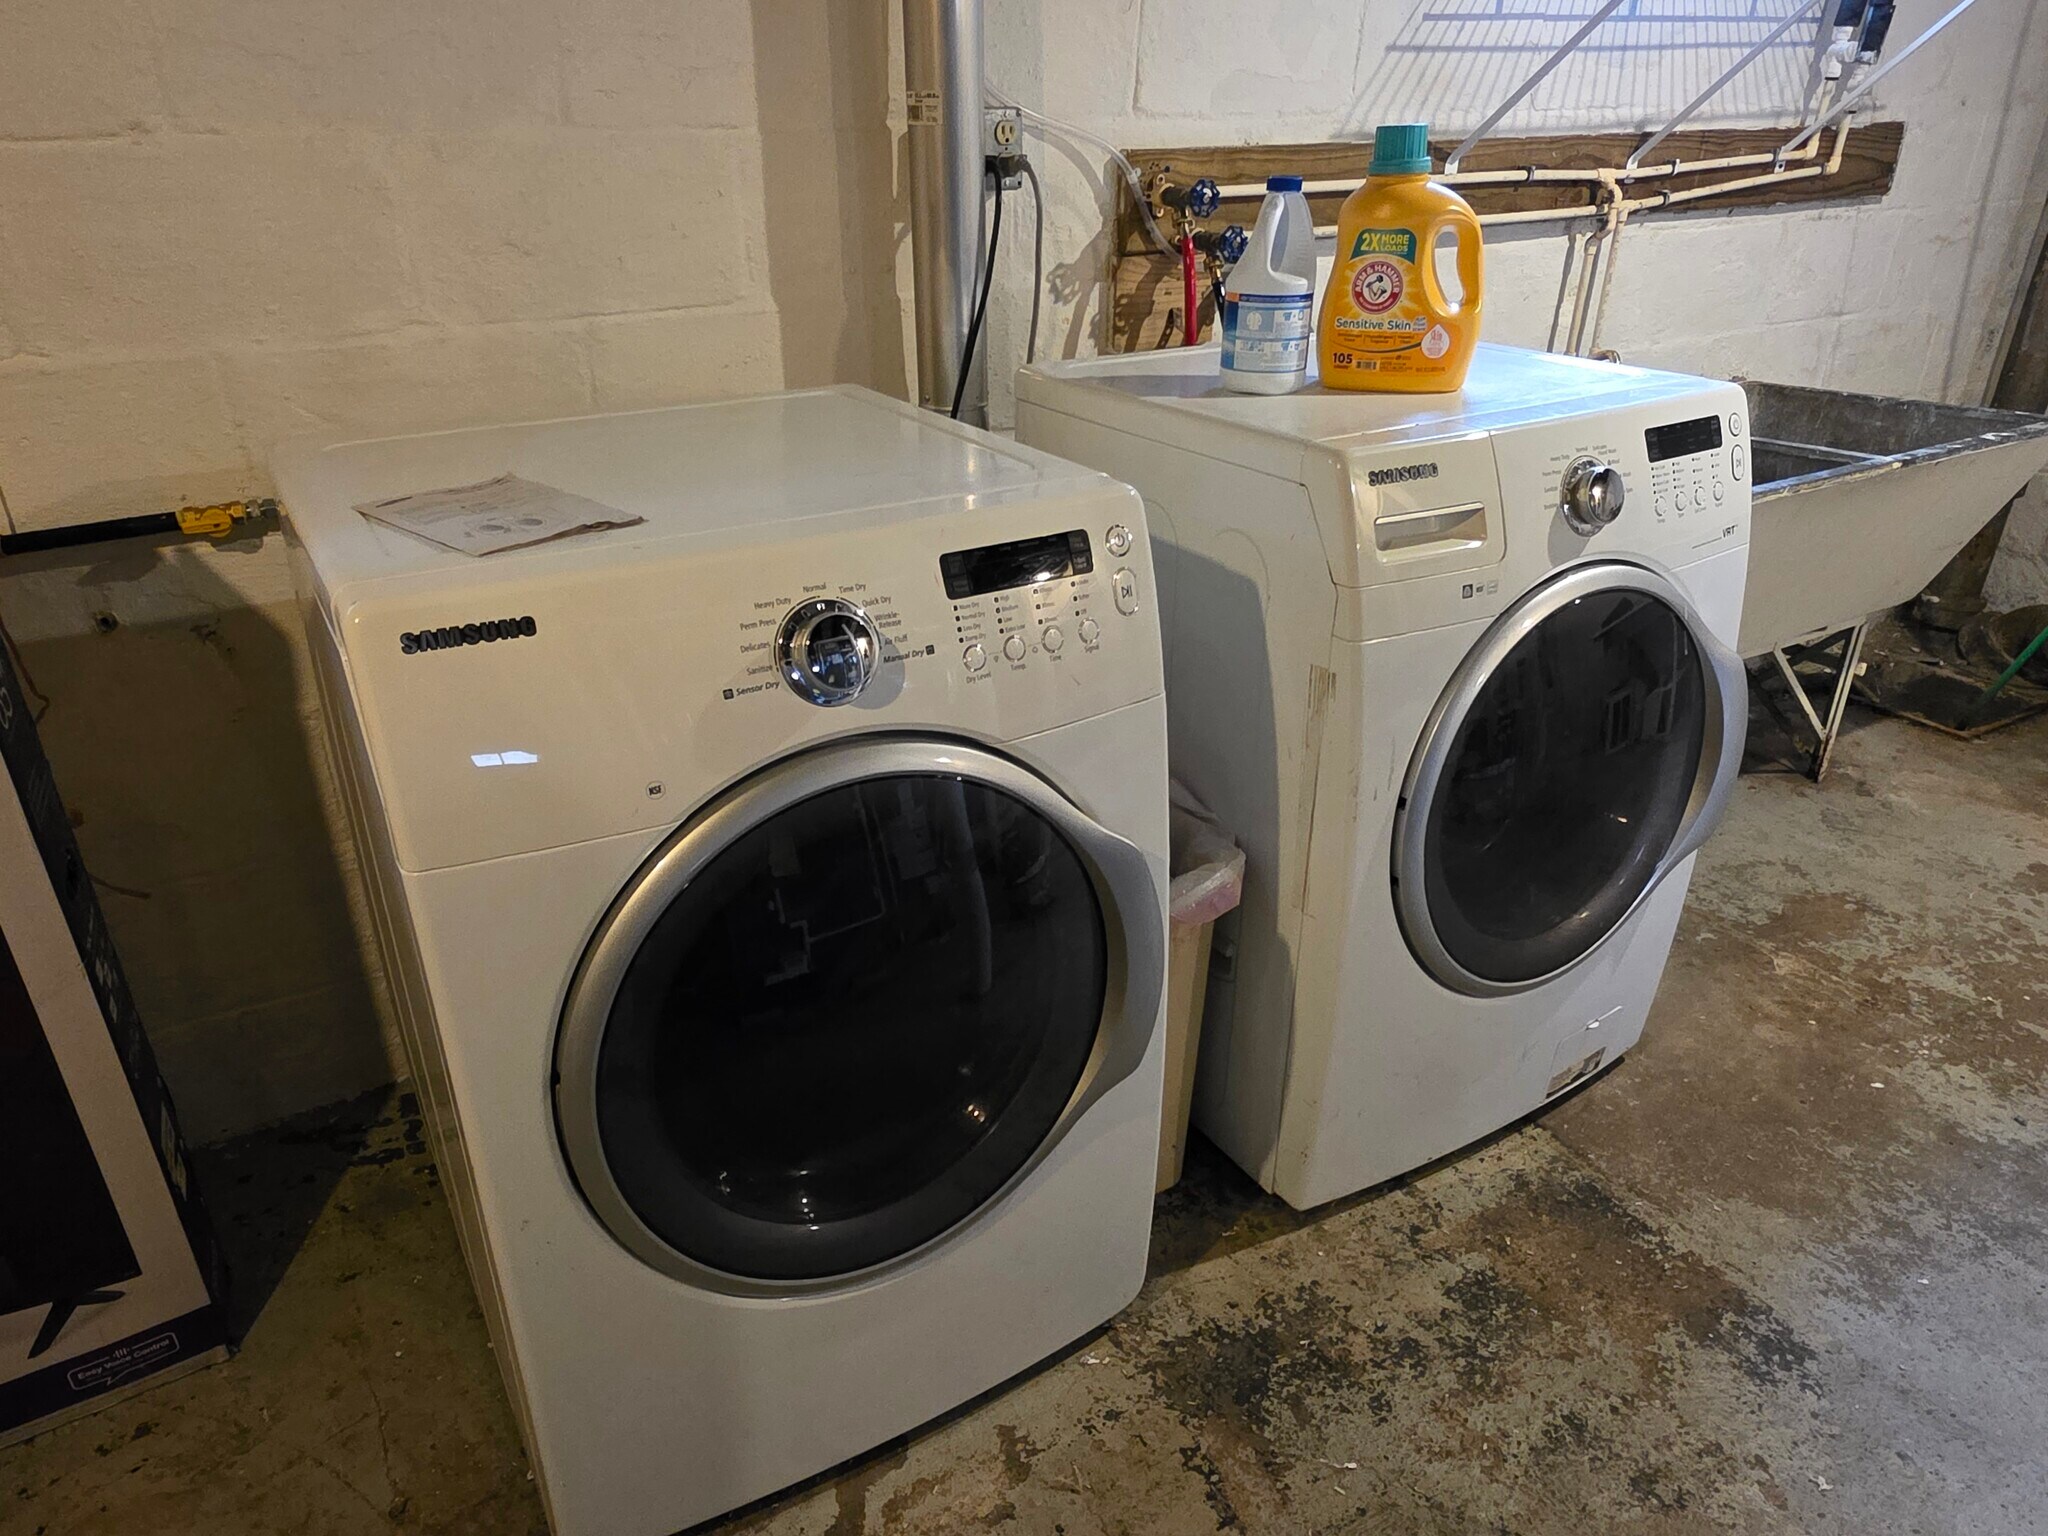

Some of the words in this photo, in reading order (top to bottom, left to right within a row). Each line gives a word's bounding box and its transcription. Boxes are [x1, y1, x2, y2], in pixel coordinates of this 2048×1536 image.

[1360, 232, 1381, 251] 2X
[1381, 234, 1410, 246] MORE
[1380, 244, 1409, 252] LOADS
[1355, 270, 1368, 293] ARM
[1374, 264, 1401, 293] HAMMER
[1336, 317, 1384, 330] Sensitive
[1387, 320, 1411, 331] Skin
[1333, 352, 1353, 364] 105
[1368, 462, 1439, 486] SAMSUNG
[803, 582, 827, 593] Normal
[838, 586, 854, 594] Time
[855, 583, 867, 591] Dry
[754, 601, 775, 610] Heavy
[776, 597, 792, 606] Duty
[862, 598, 879, 608] Quick
[880, 596, 892, 604] Dry
[740, 621, 758, 631] Perm
[759, 618, 777, 628] Press
[400, 615, 537, 655] SAMSUNG
[740, 641, 771, 654] Delicates
[883, 651, 911, 664] Manual
[911, 648, 925, 658] Dry
[746, 664, 773, 676] Sanitize
[966, 674, 976, 684] Dry
[736, 684, 763, 697] Sensor
[765, 681, 781, 691] Dry
[77, 1366, 103, 1380] Easy
[103, 1356, 132, 1369] Voice
[133, 1339, 170, 1359] Control
